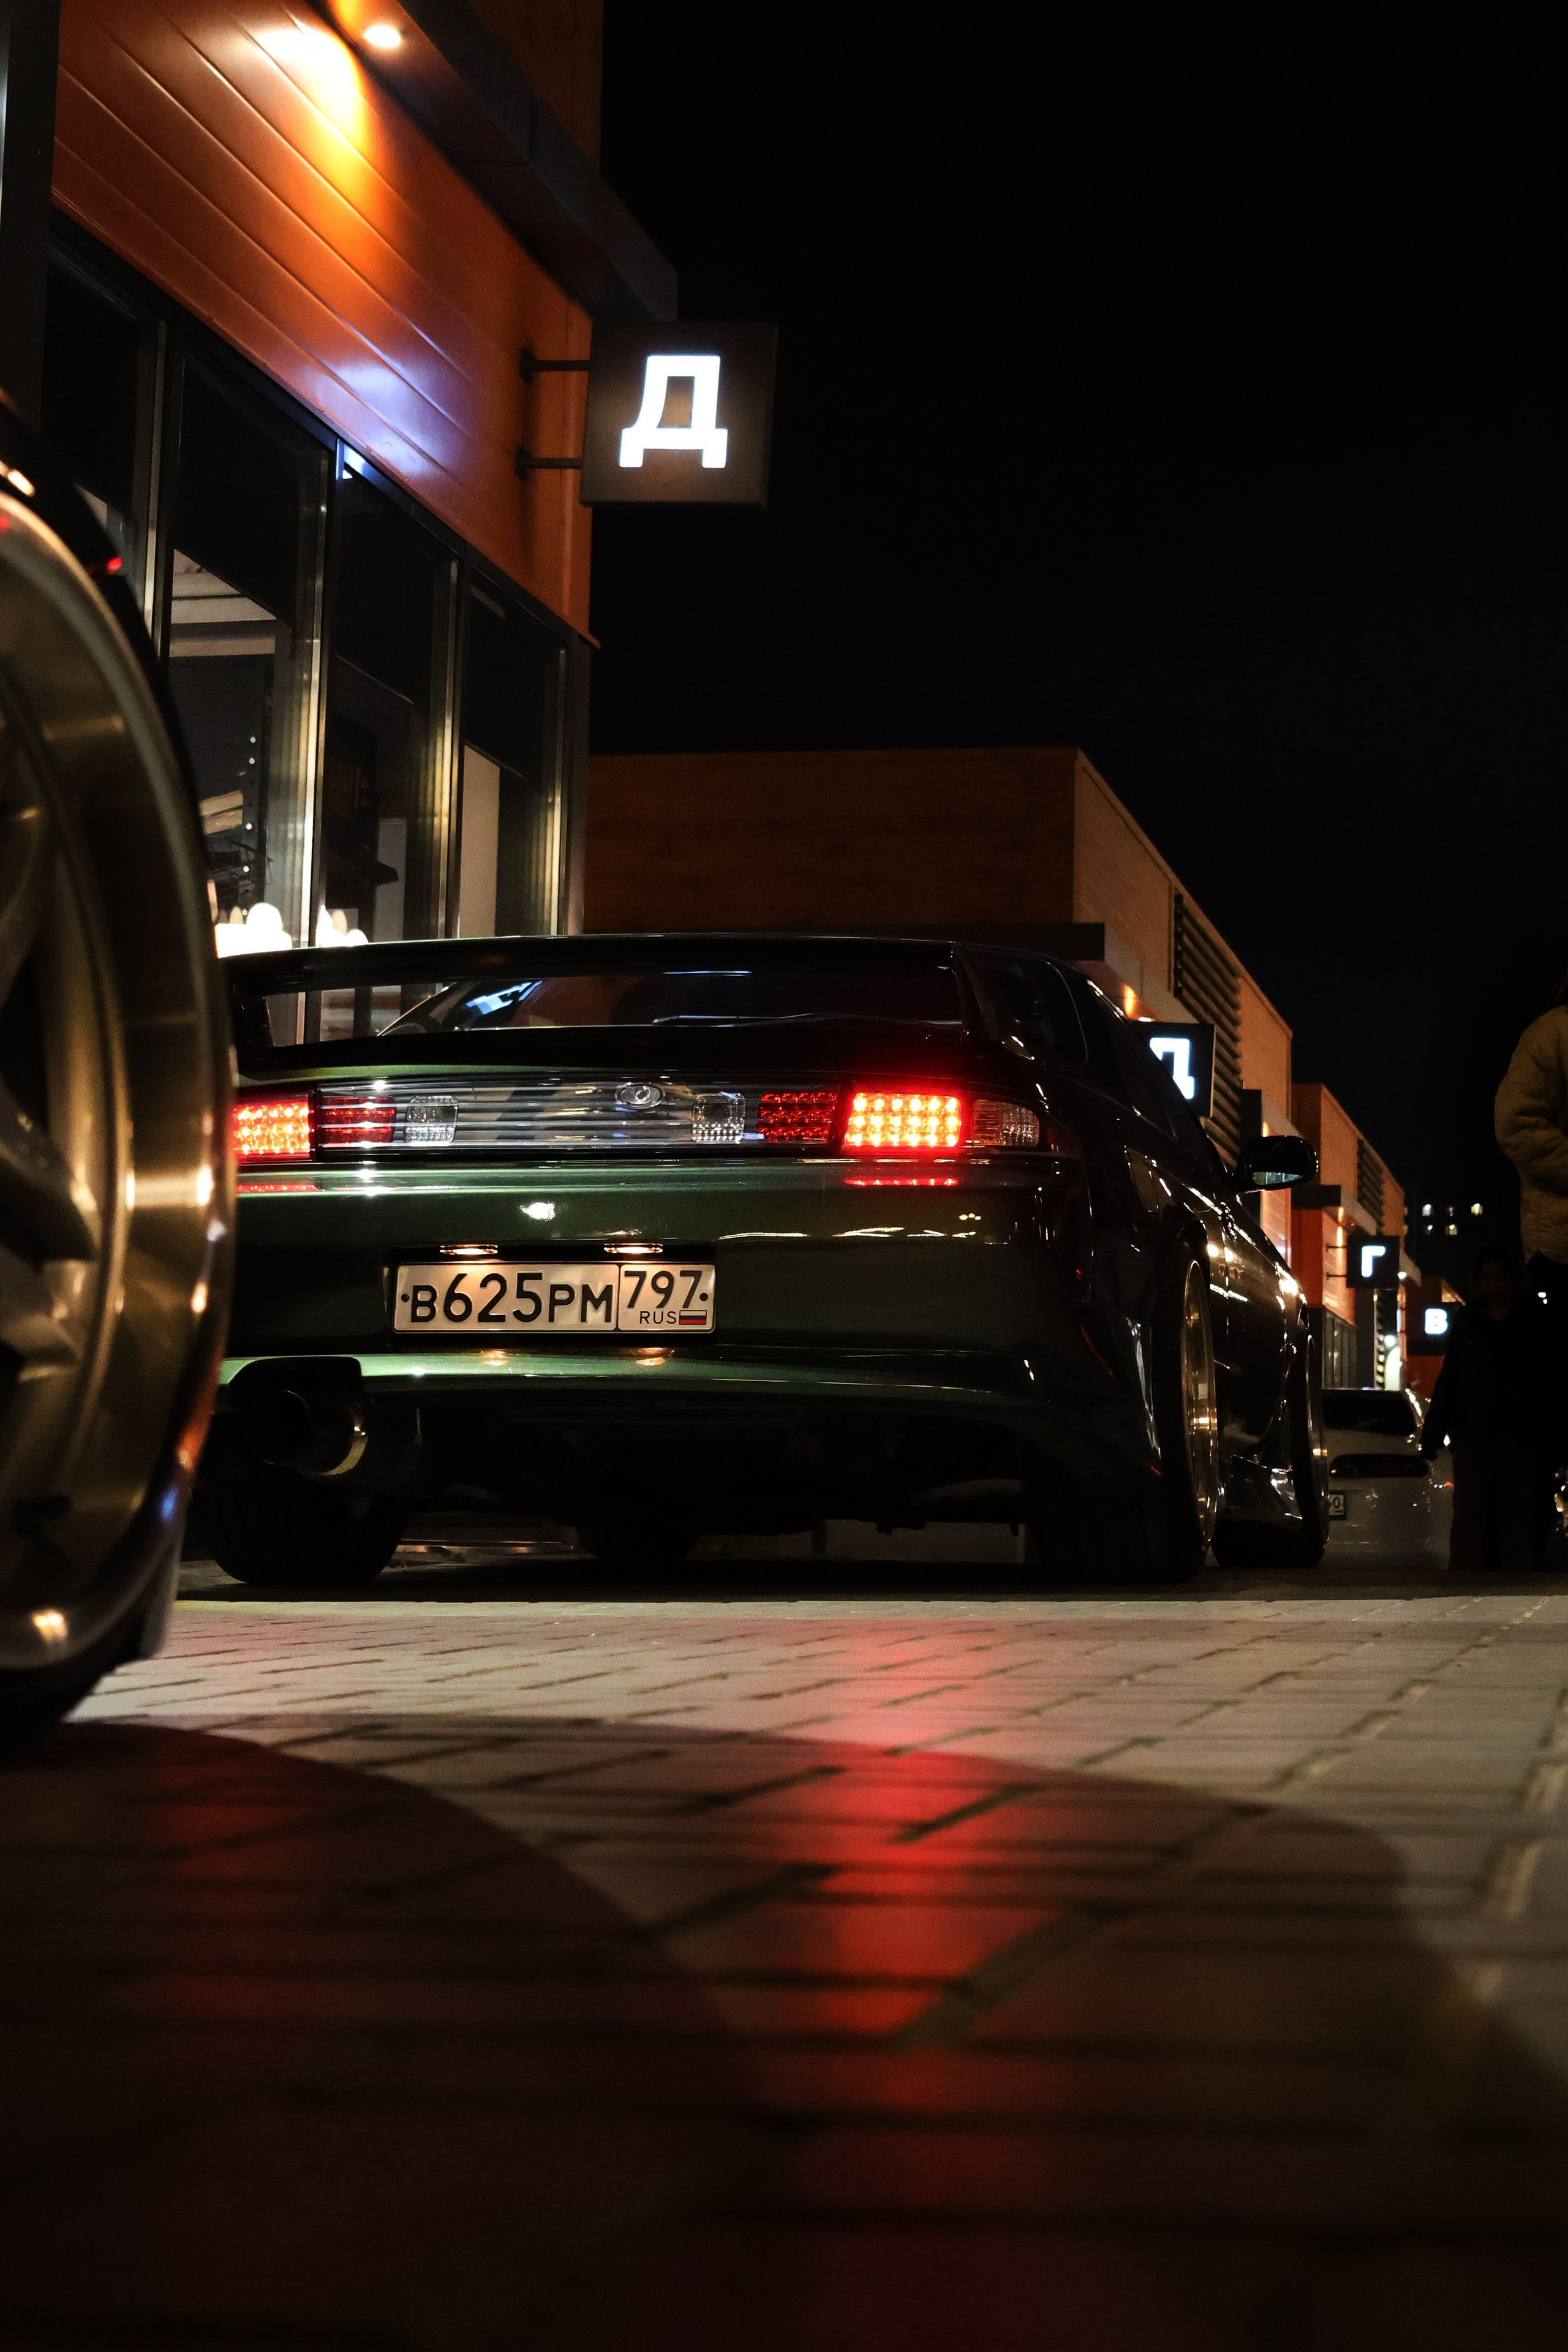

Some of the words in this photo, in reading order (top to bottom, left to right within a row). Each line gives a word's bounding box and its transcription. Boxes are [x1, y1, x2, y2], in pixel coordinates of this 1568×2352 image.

[619, 354, 728, 469] Д
[1361, 1245, 1385, 1278] Г
[624, 1270, 703, 1309] 797
[639, 1310, 677, 1324] RUS
